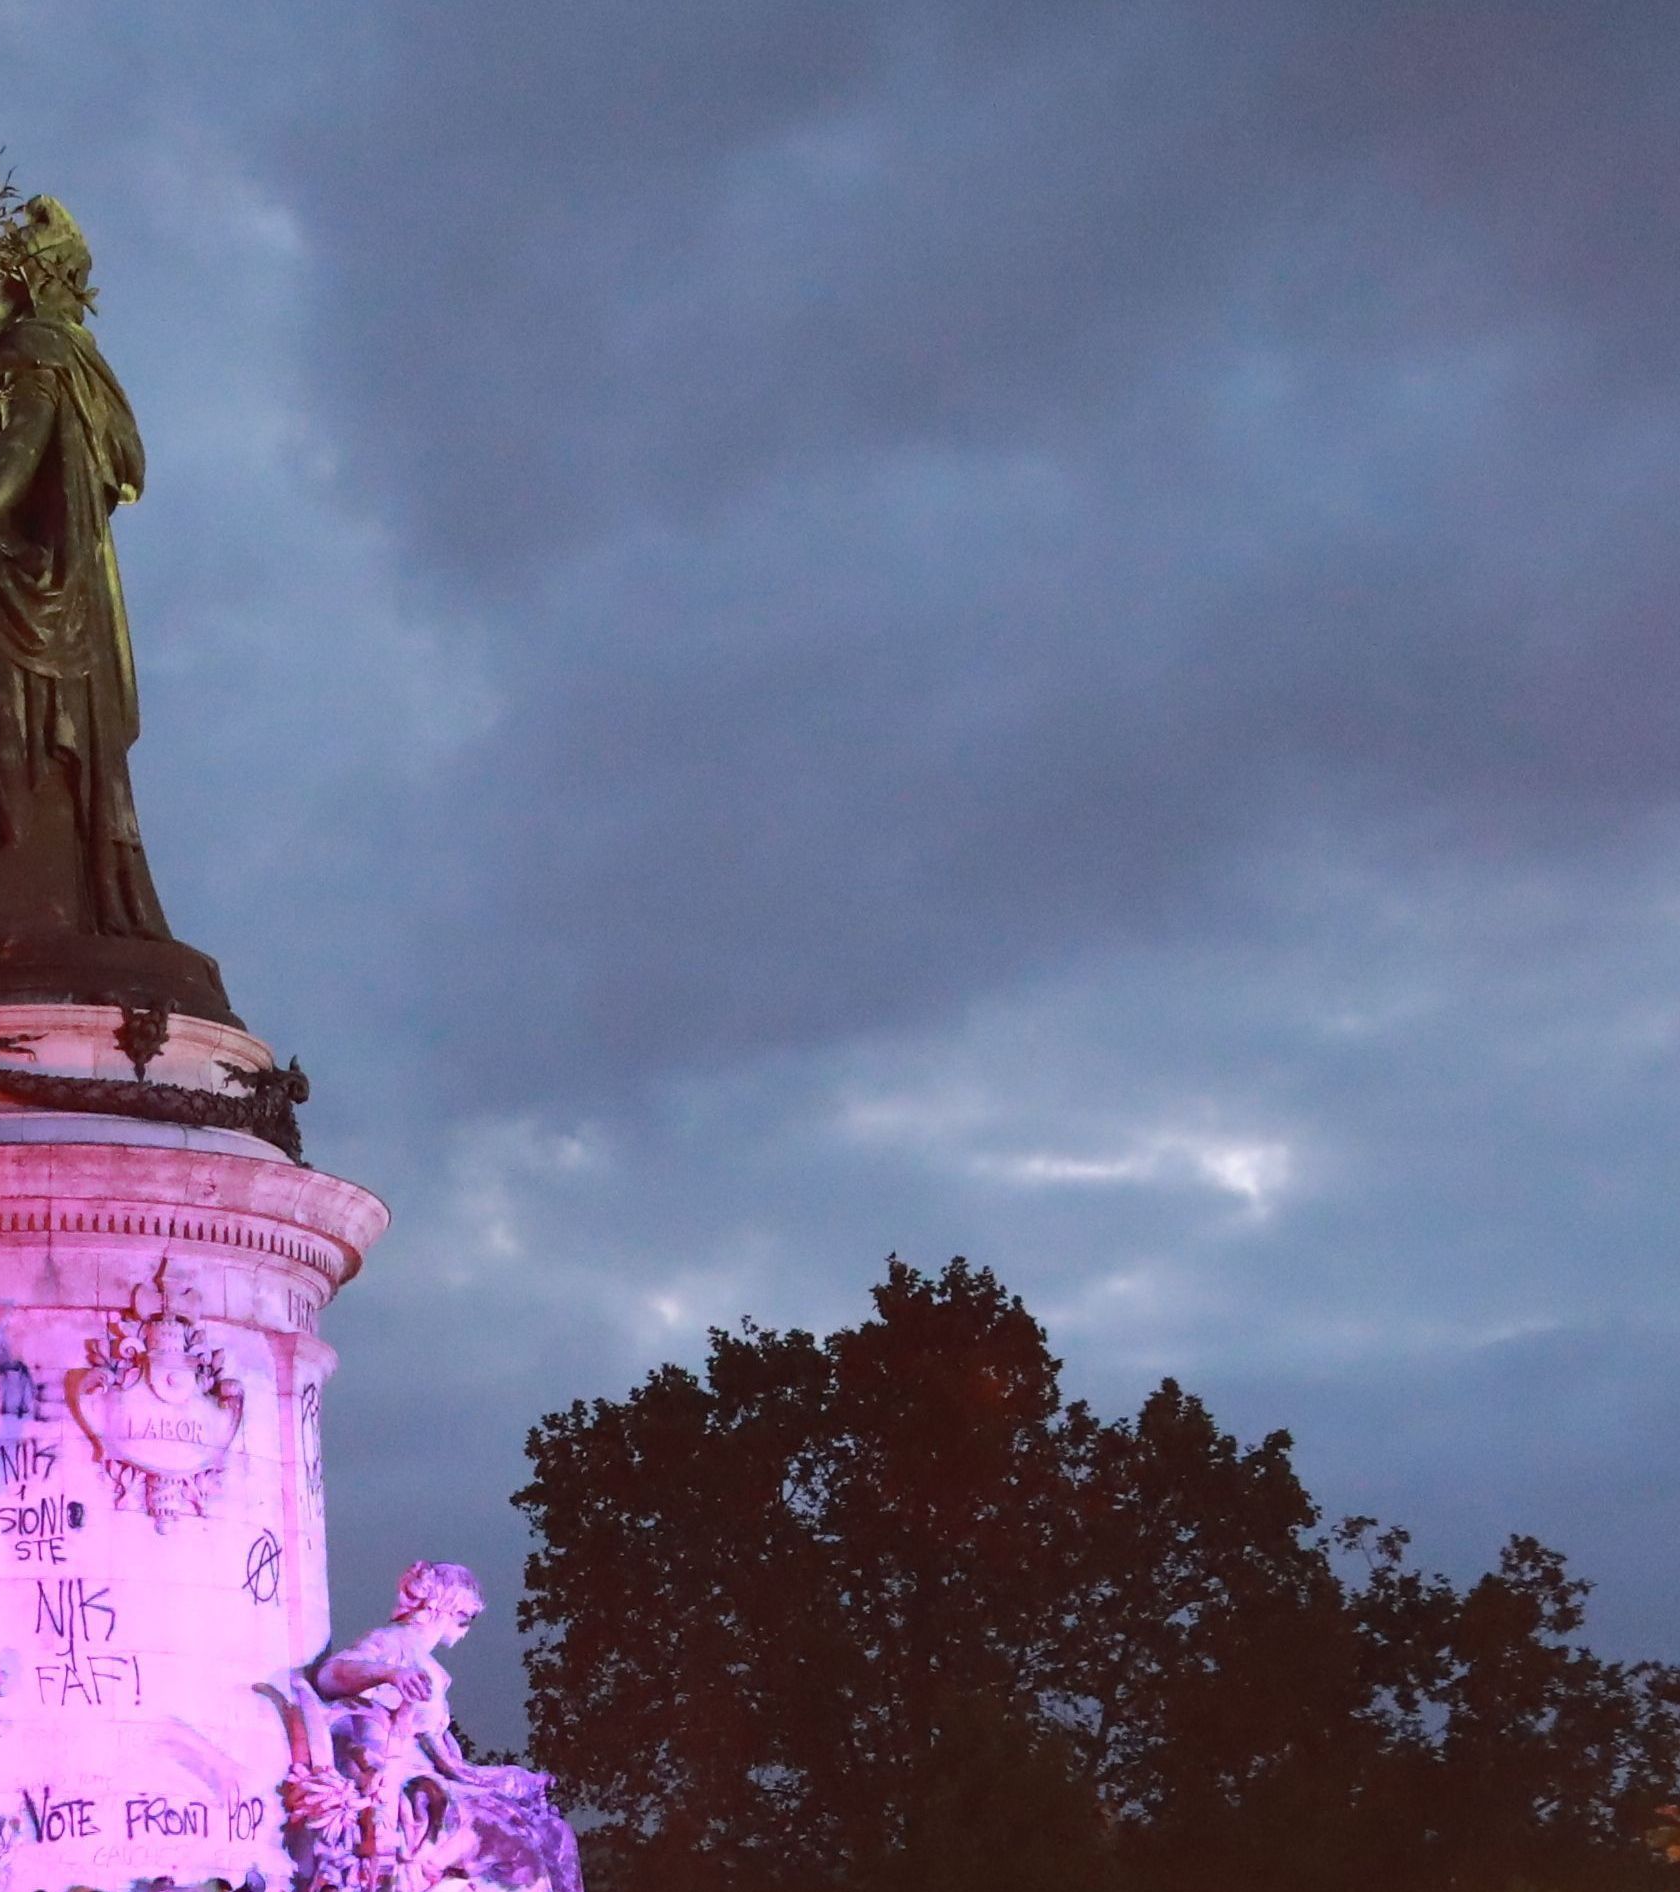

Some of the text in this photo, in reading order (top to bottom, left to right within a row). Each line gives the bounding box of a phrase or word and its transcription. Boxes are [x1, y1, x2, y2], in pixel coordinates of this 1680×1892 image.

[127, 1418, 203, 1444] LABOR
[0, 1438, 58, 1484] NIK
[15, 1536, 68, 1565] STE
[36, 1577, 116, 1642] NIK
[22, 1781, 265, 1843] VOTE FRONT POP
